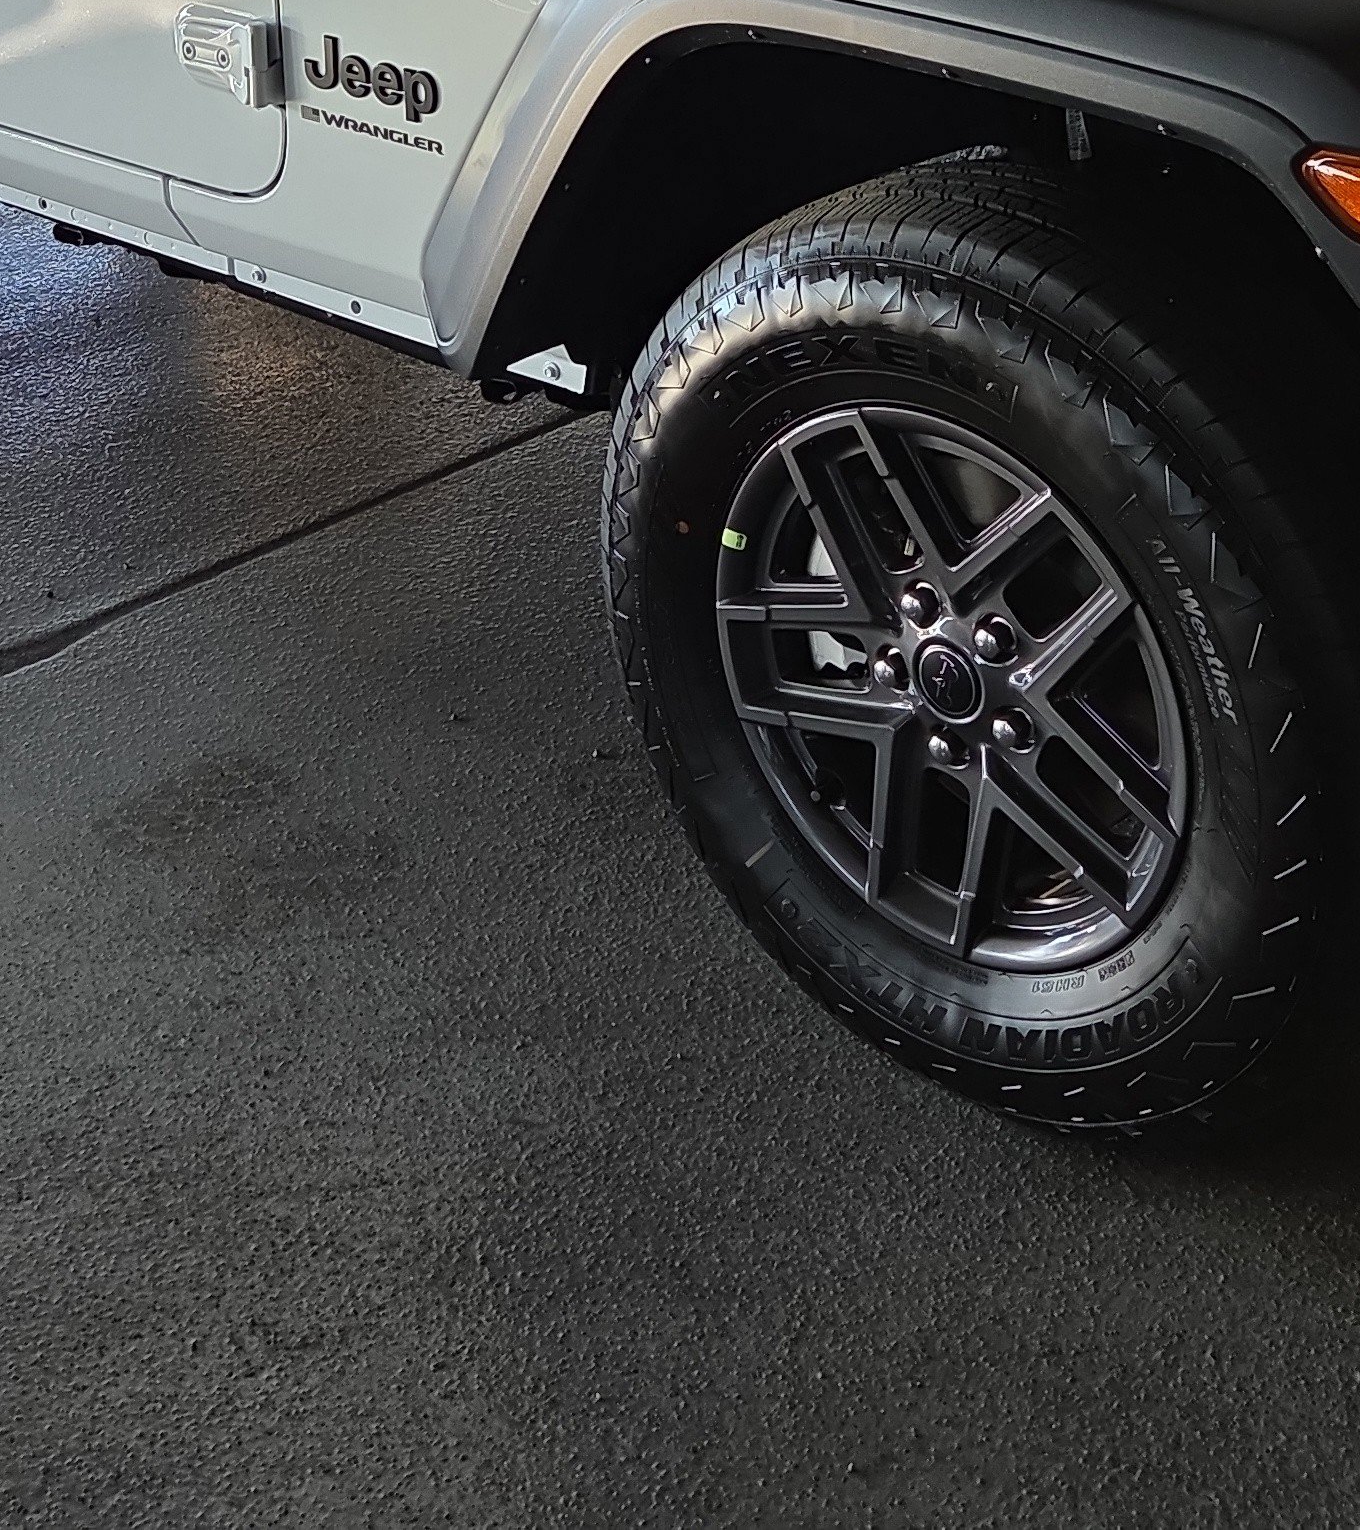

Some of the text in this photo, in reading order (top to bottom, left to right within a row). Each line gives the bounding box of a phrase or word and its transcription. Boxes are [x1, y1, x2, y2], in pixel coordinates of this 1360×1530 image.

[304, 34, 440, 123] Jeep
[320, 109, 445, 156] WRANGLER
[724, 333, 984, 403] NEXEN
[1145, 535, 1239, 726] All-Weather
[959, 970, 1187, 1065] ROADIAN
